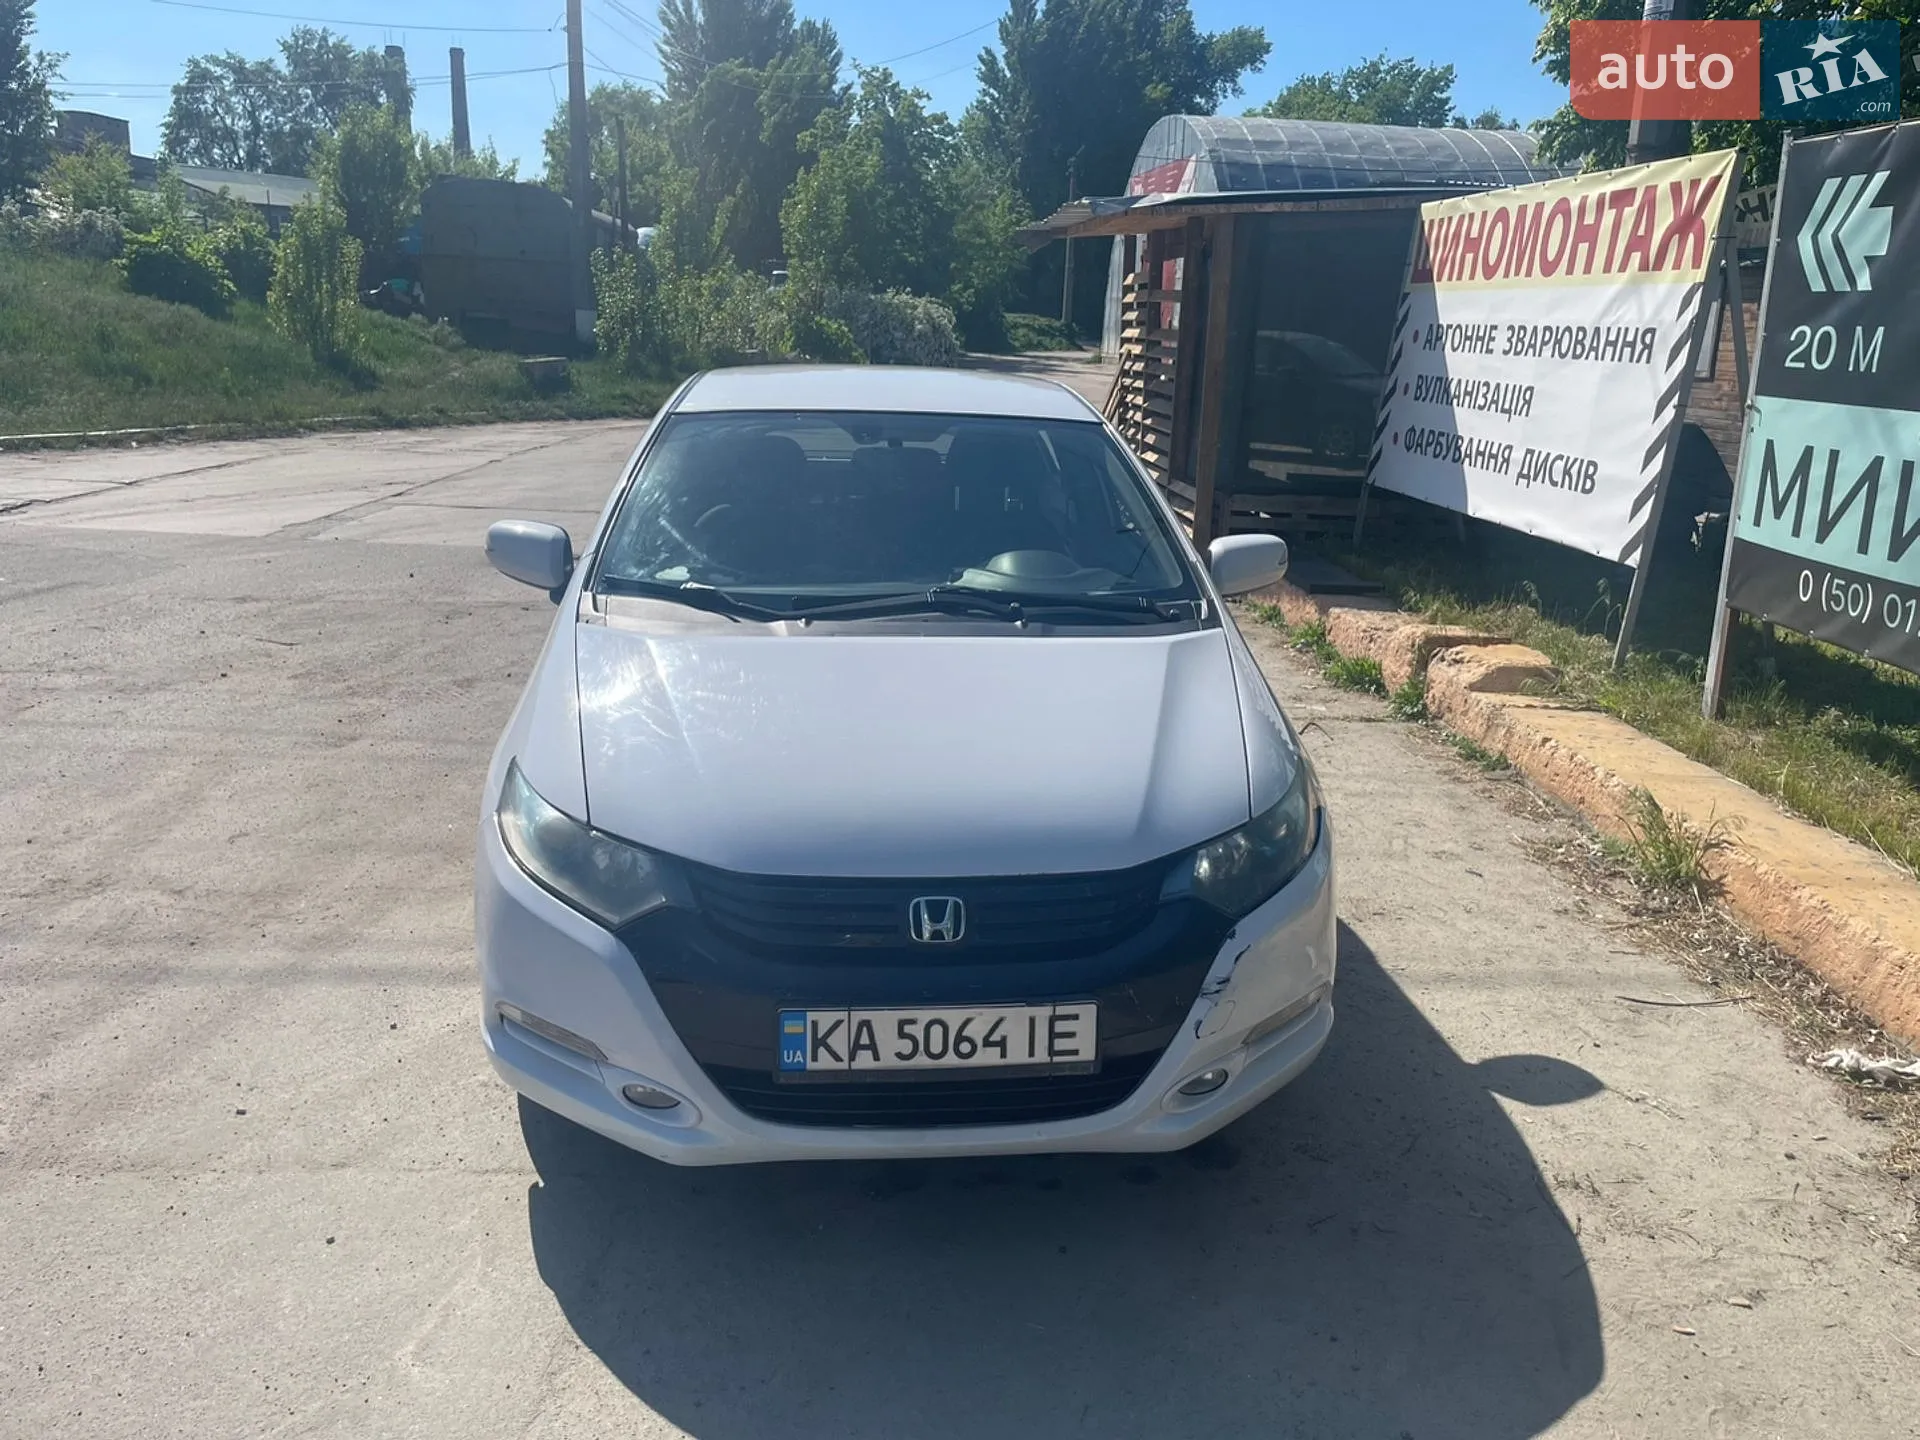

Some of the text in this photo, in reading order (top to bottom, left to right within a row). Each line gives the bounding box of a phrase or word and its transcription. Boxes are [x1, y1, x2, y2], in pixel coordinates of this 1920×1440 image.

[1410, 174, 1724, 284] ШИНОМОНТАЖ
[1422, 323, 1657, 364] АРГОННЕ ЗВАРЮВАННЯ
[1784, 325, 1885, 374] 20 М
[1413, 374, 1535, 423] ВУЛКАНІЗАЦІЯ
[1404, 424, 1599, 495] ФАРБУВАННЯ ДИСКІВ
[1799, 569, 1920, 638] 0 (50) 01
[783, 1050, 804, 1064] UA
[810, 1013, 1080, 1063] KA 5064 IE
